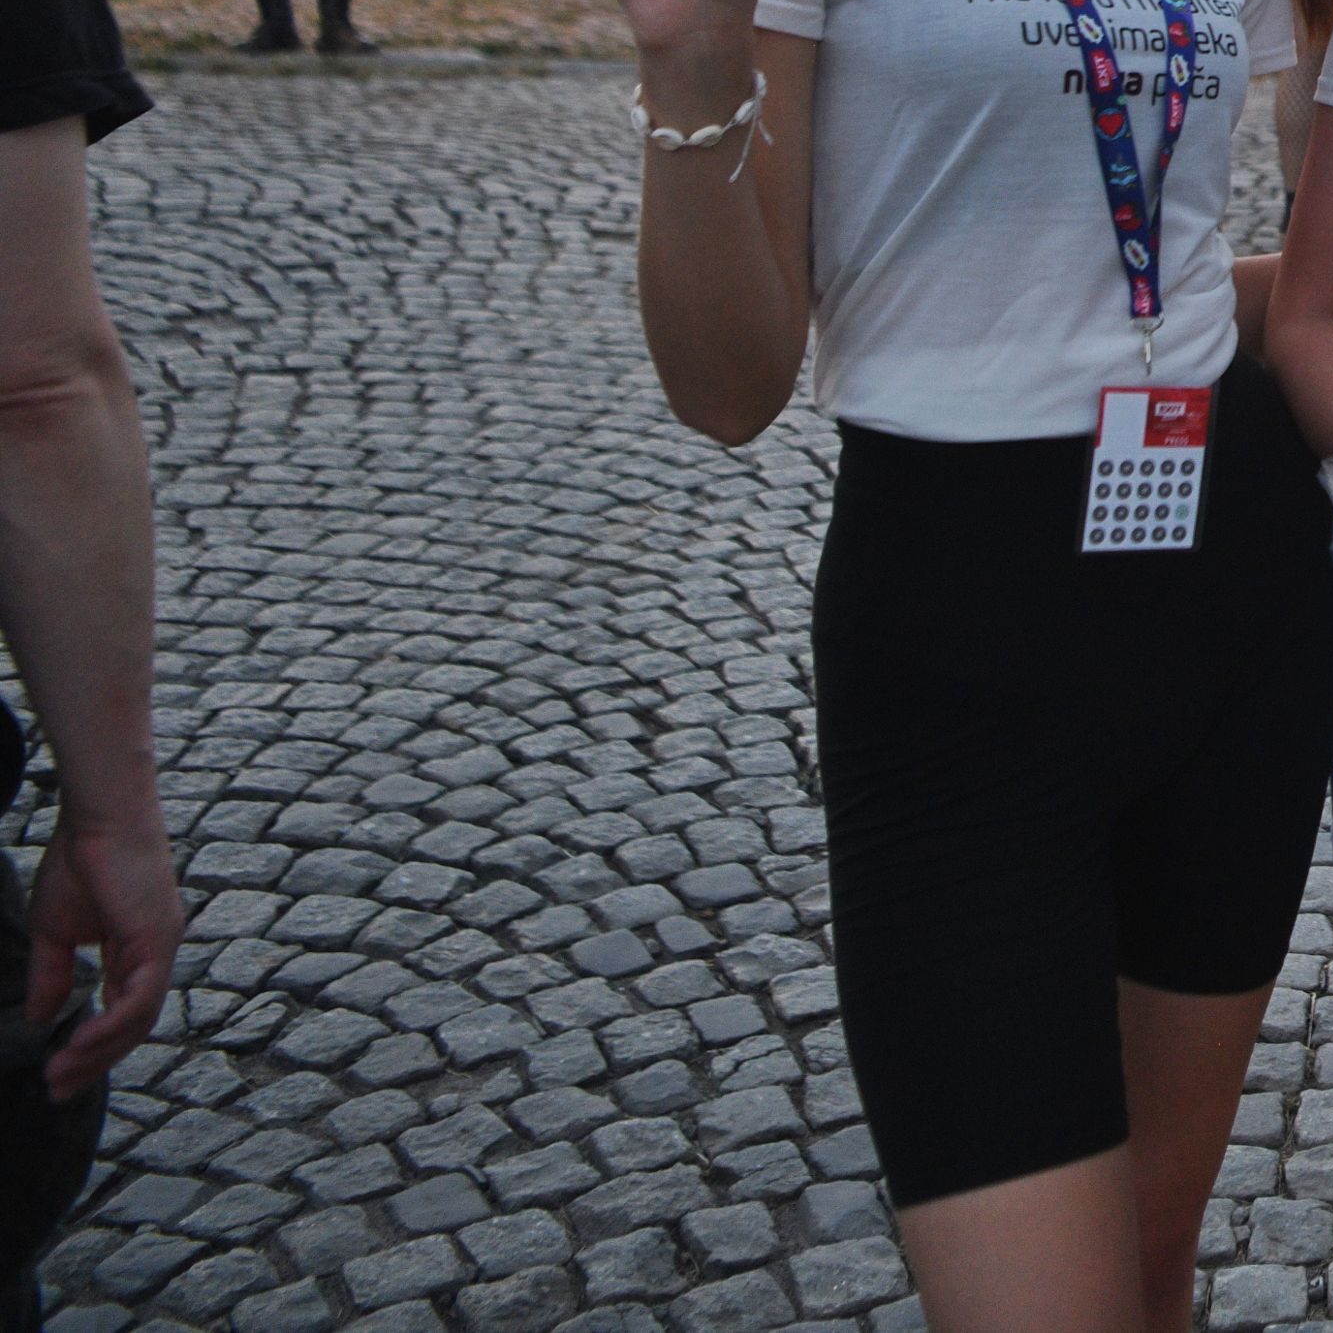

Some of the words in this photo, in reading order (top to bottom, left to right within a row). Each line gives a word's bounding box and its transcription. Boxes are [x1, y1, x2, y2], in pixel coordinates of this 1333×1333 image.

[1022, 21, 1082, 46] uve
[1109, 18, 1166, 52] ima
[1195, 22, 1238, 57] eka
[1094, 55, 1110, 88] EXIT
[1170, 96, 1181, 128] EXIT
